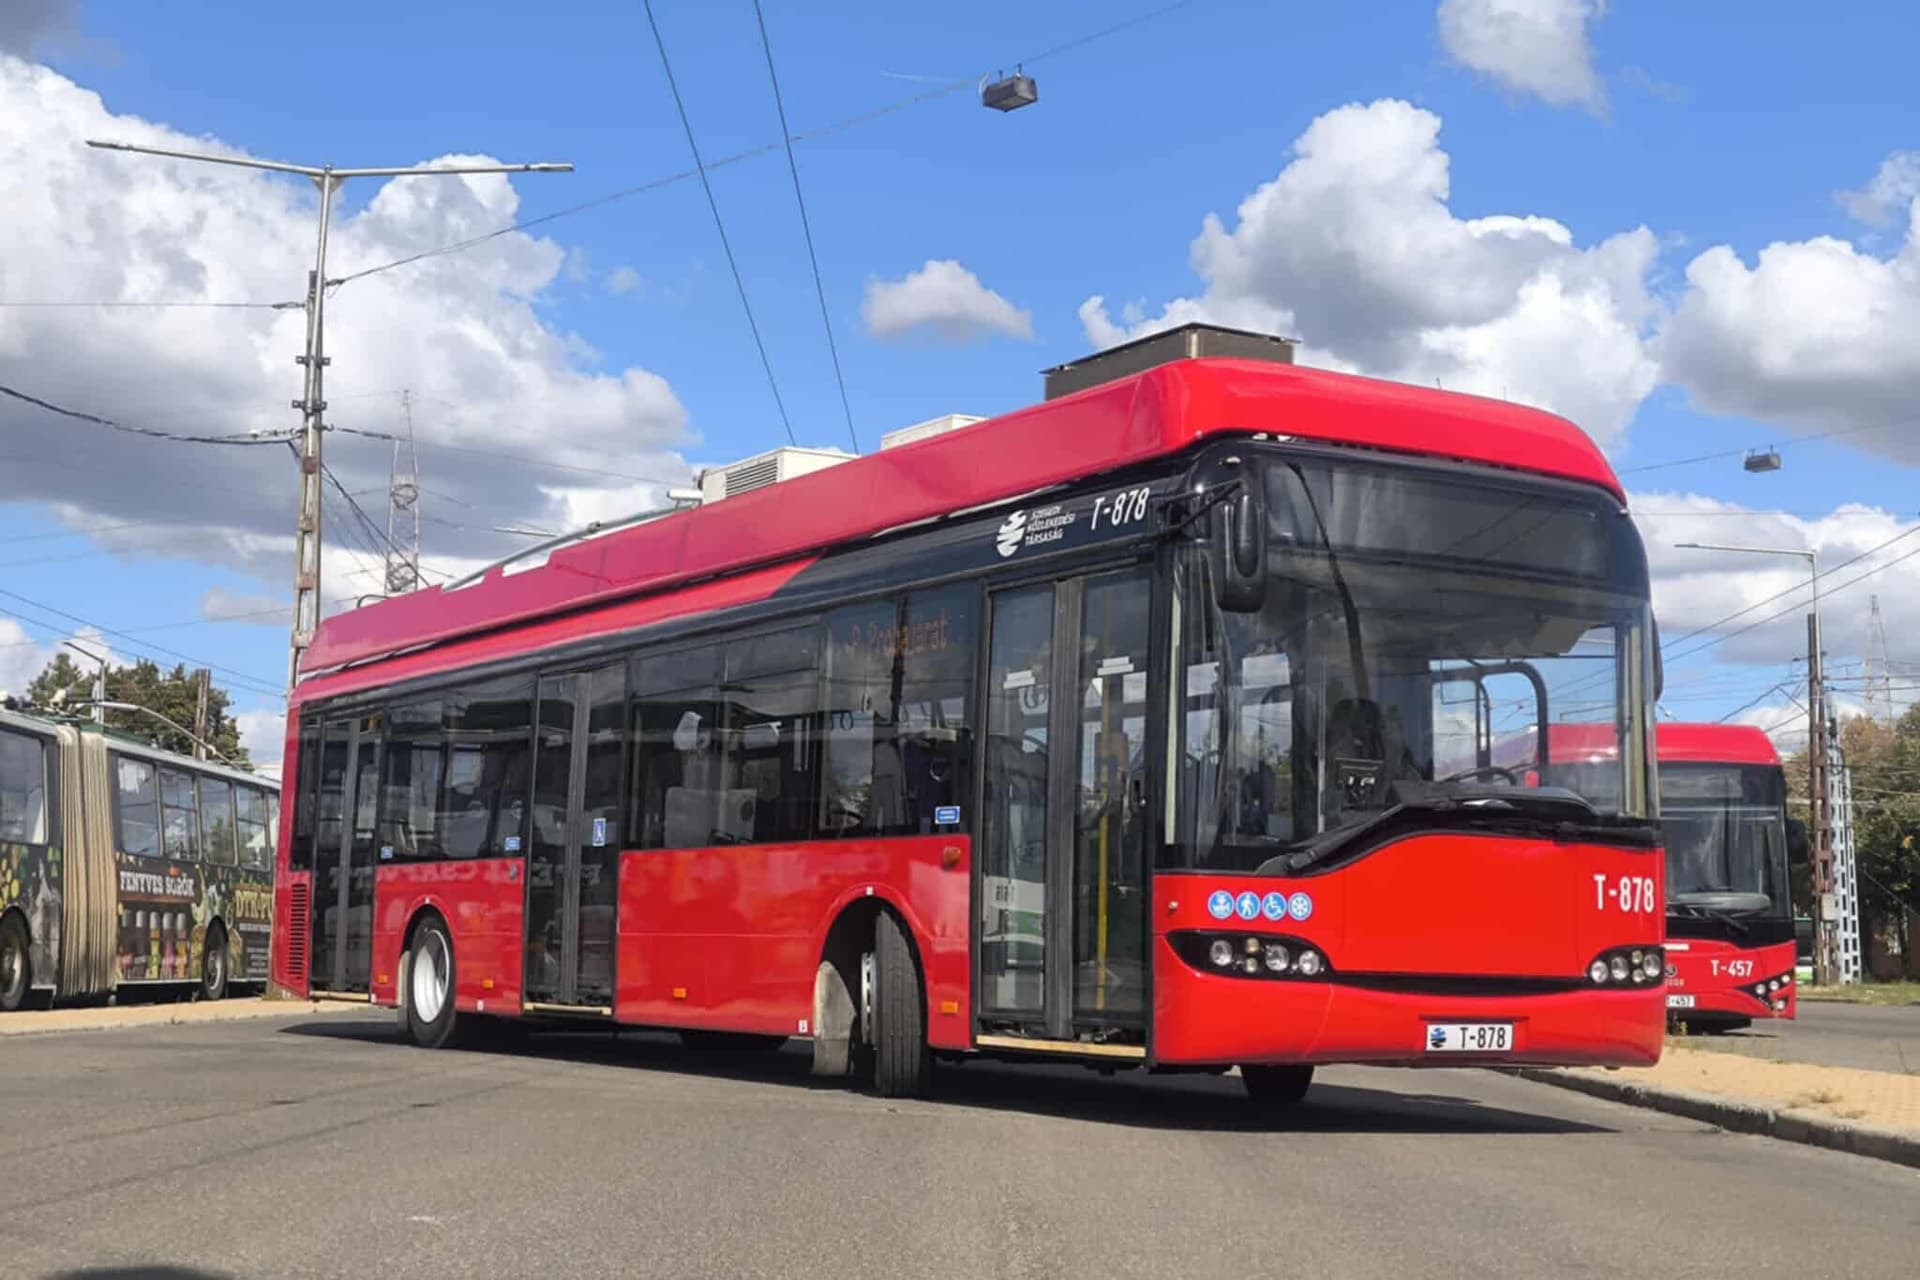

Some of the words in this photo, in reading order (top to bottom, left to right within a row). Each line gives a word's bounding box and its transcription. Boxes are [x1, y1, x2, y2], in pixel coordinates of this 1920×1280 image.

[1091, 487, 1150, 530] T-878
[119, 870, 164, 895] FENYVES
[1593, 874, 1655, 913] T-878
[1710, 959, 1754, 978] T-457
[1460, 1026, 1506, 1049] T-878
